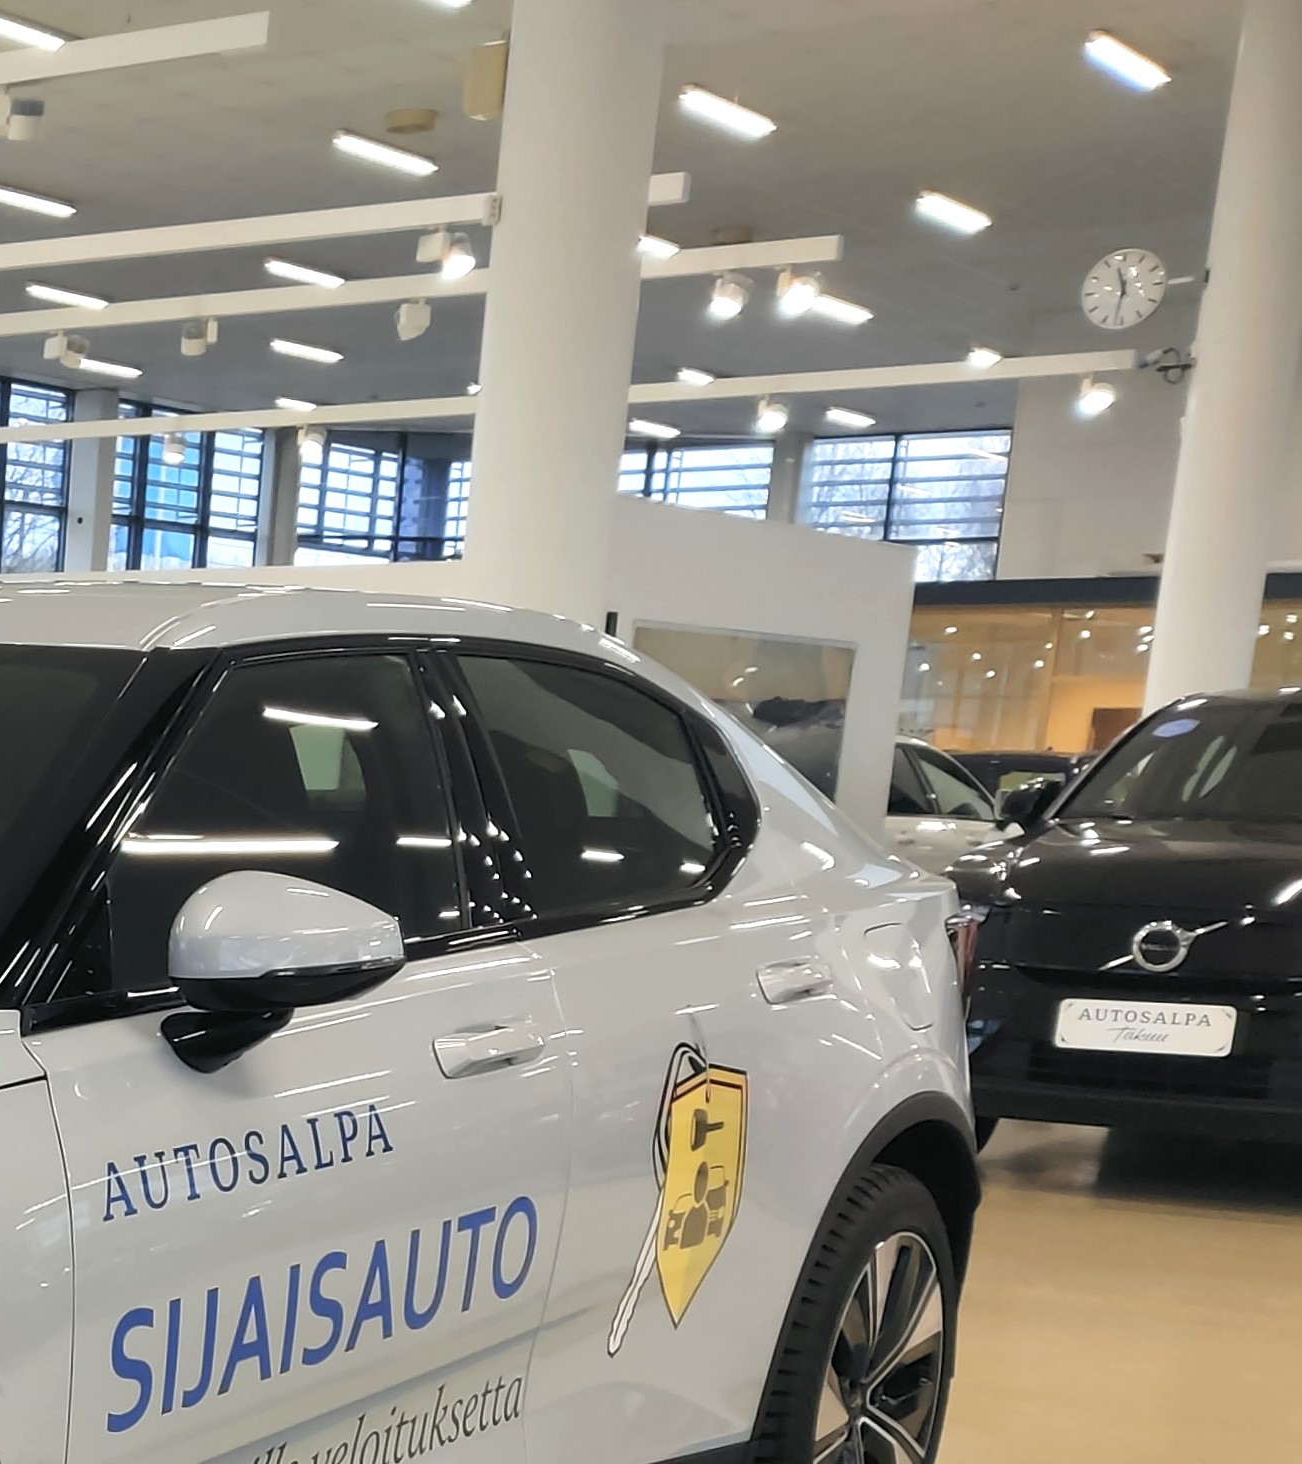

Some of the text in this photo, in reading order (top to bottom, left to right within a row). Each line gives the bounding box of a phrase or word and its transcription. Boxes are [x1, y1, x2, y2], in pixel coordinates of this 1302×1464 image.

[1078, 1008, 1212, 1028] AUTOSALPA
[1107, 1026, 1169, 1044] Takuu
[102, 1104, 393, 1222] AUTOSALPA
[106, 1196, 538, 1433] SIJAISAUTO
